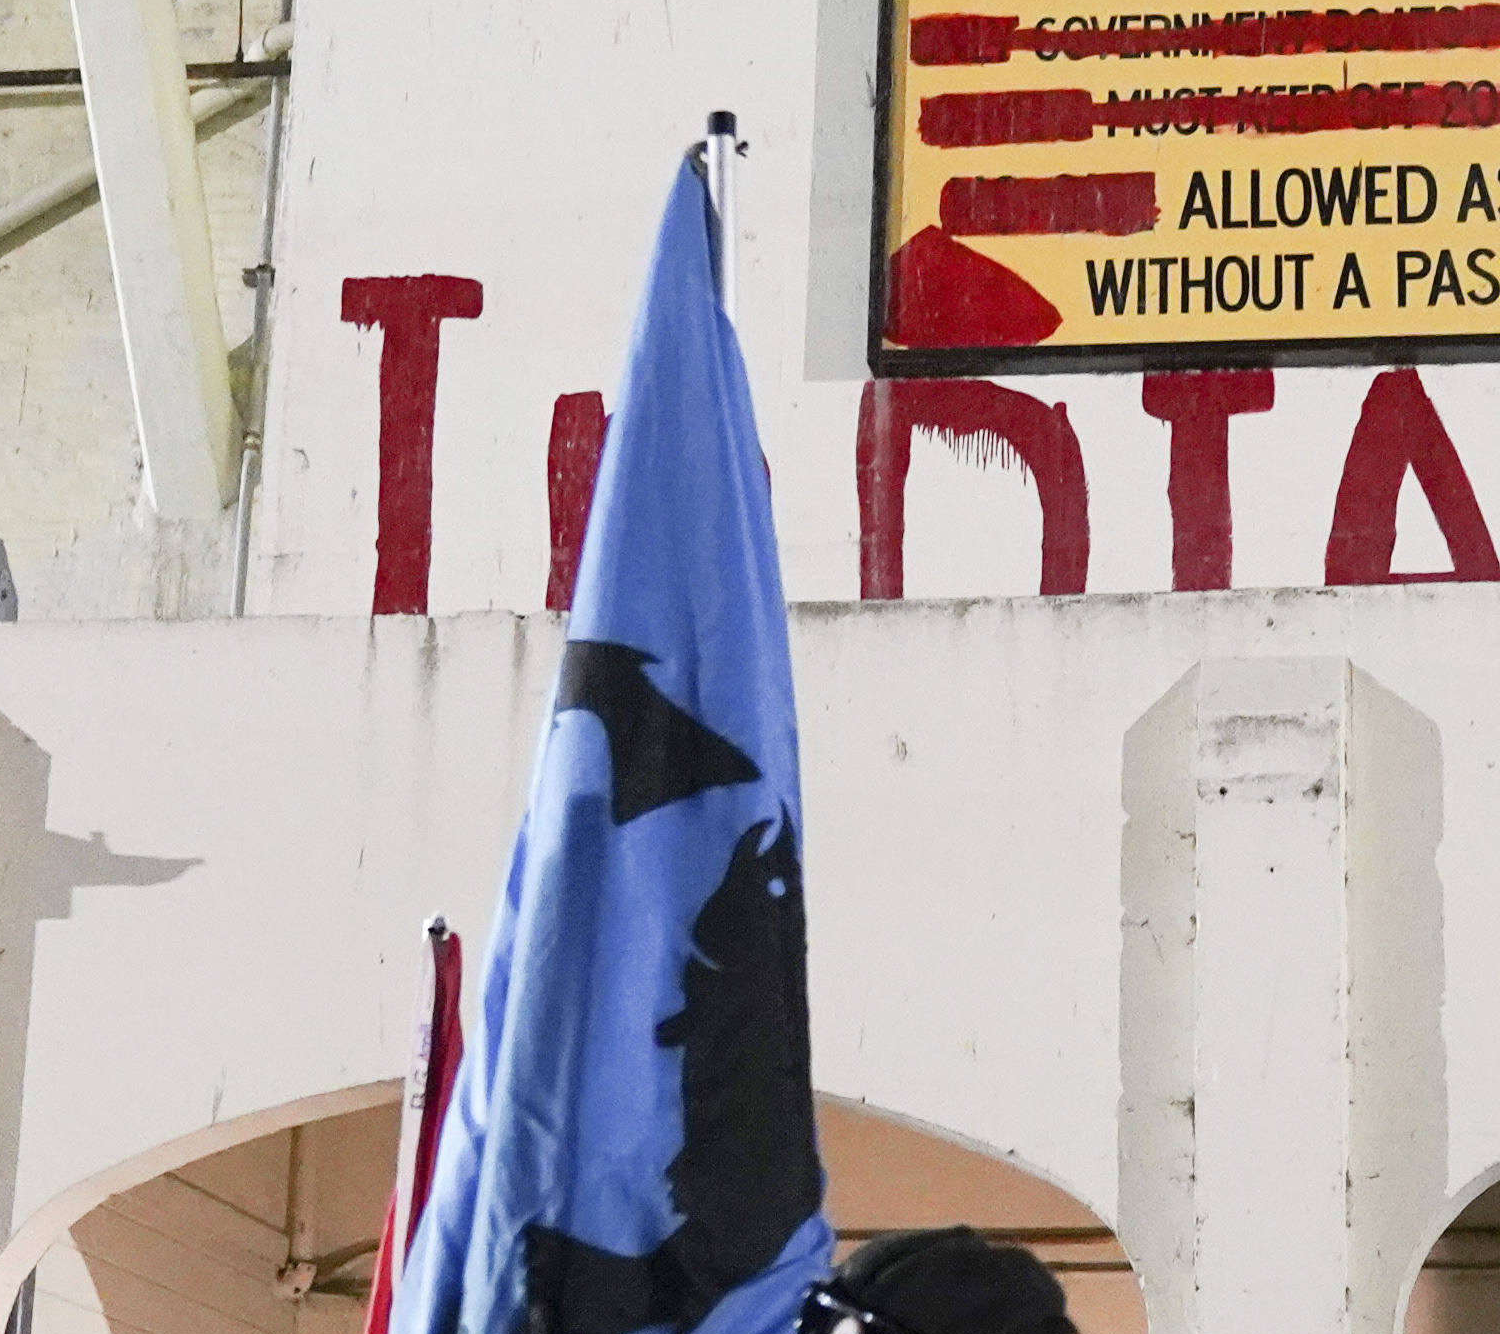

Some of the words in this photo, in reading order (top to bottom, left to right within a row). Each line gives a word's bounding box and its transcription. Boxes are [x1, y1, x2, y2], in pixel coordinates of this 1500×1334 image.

[1177, 161, 1439, 231] ALLOWED
[1084, 253, 1315, 317] WITHOUT
[1331, 251, 1372, 311] A
